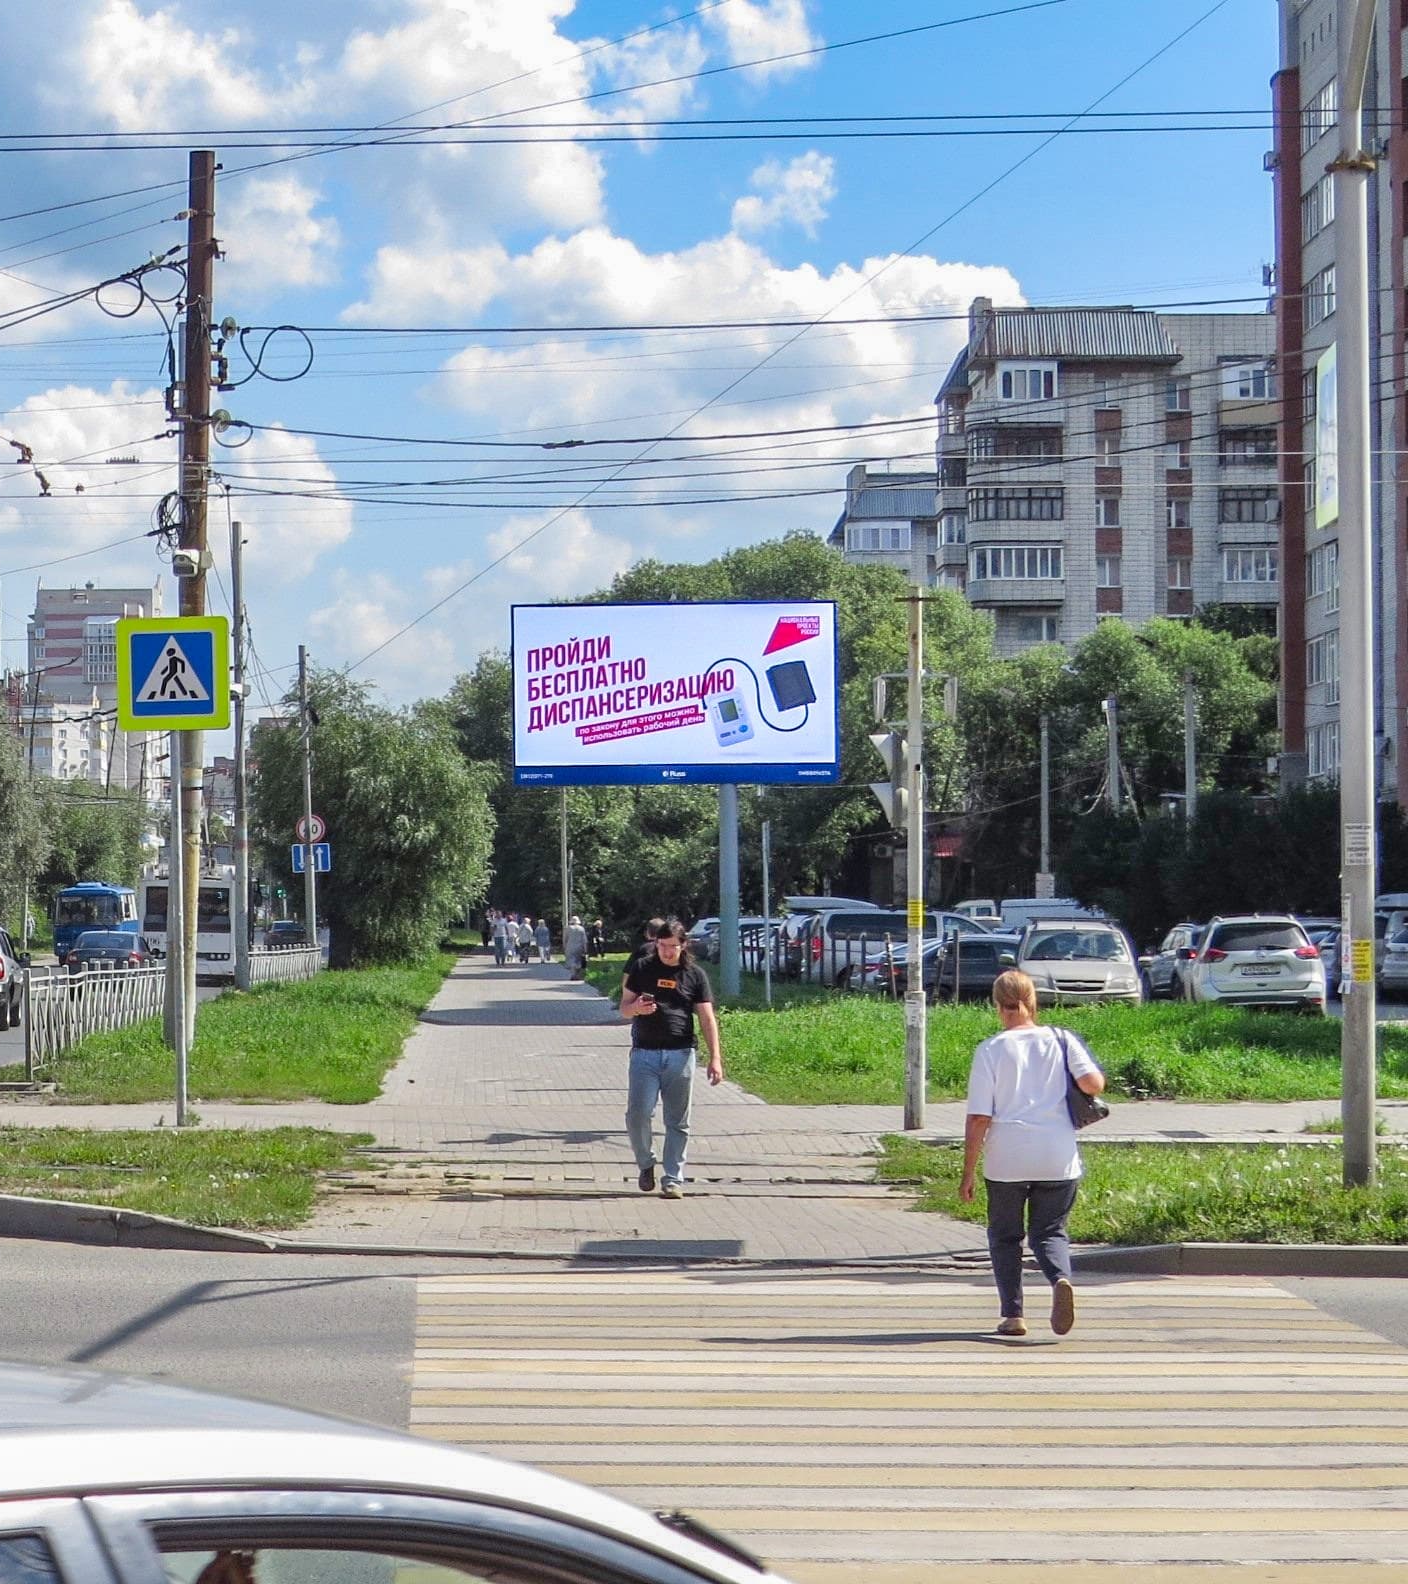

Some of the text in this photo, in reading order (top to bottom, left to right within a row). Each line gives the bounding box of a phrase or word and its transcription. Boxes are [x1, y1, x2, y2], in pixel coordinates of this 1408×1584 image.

[527, 636, 611, 673] ПРОЙДИ
[527, 657, 646, 702] БЕСПЛАТНО
[527, 668, 735, 733] ДИСПАНСЕРИЗАЦИЮ
[579, 706, 696, 736] по закону для этого можно
[583, 713, 705, 744] использовать рабочий день
